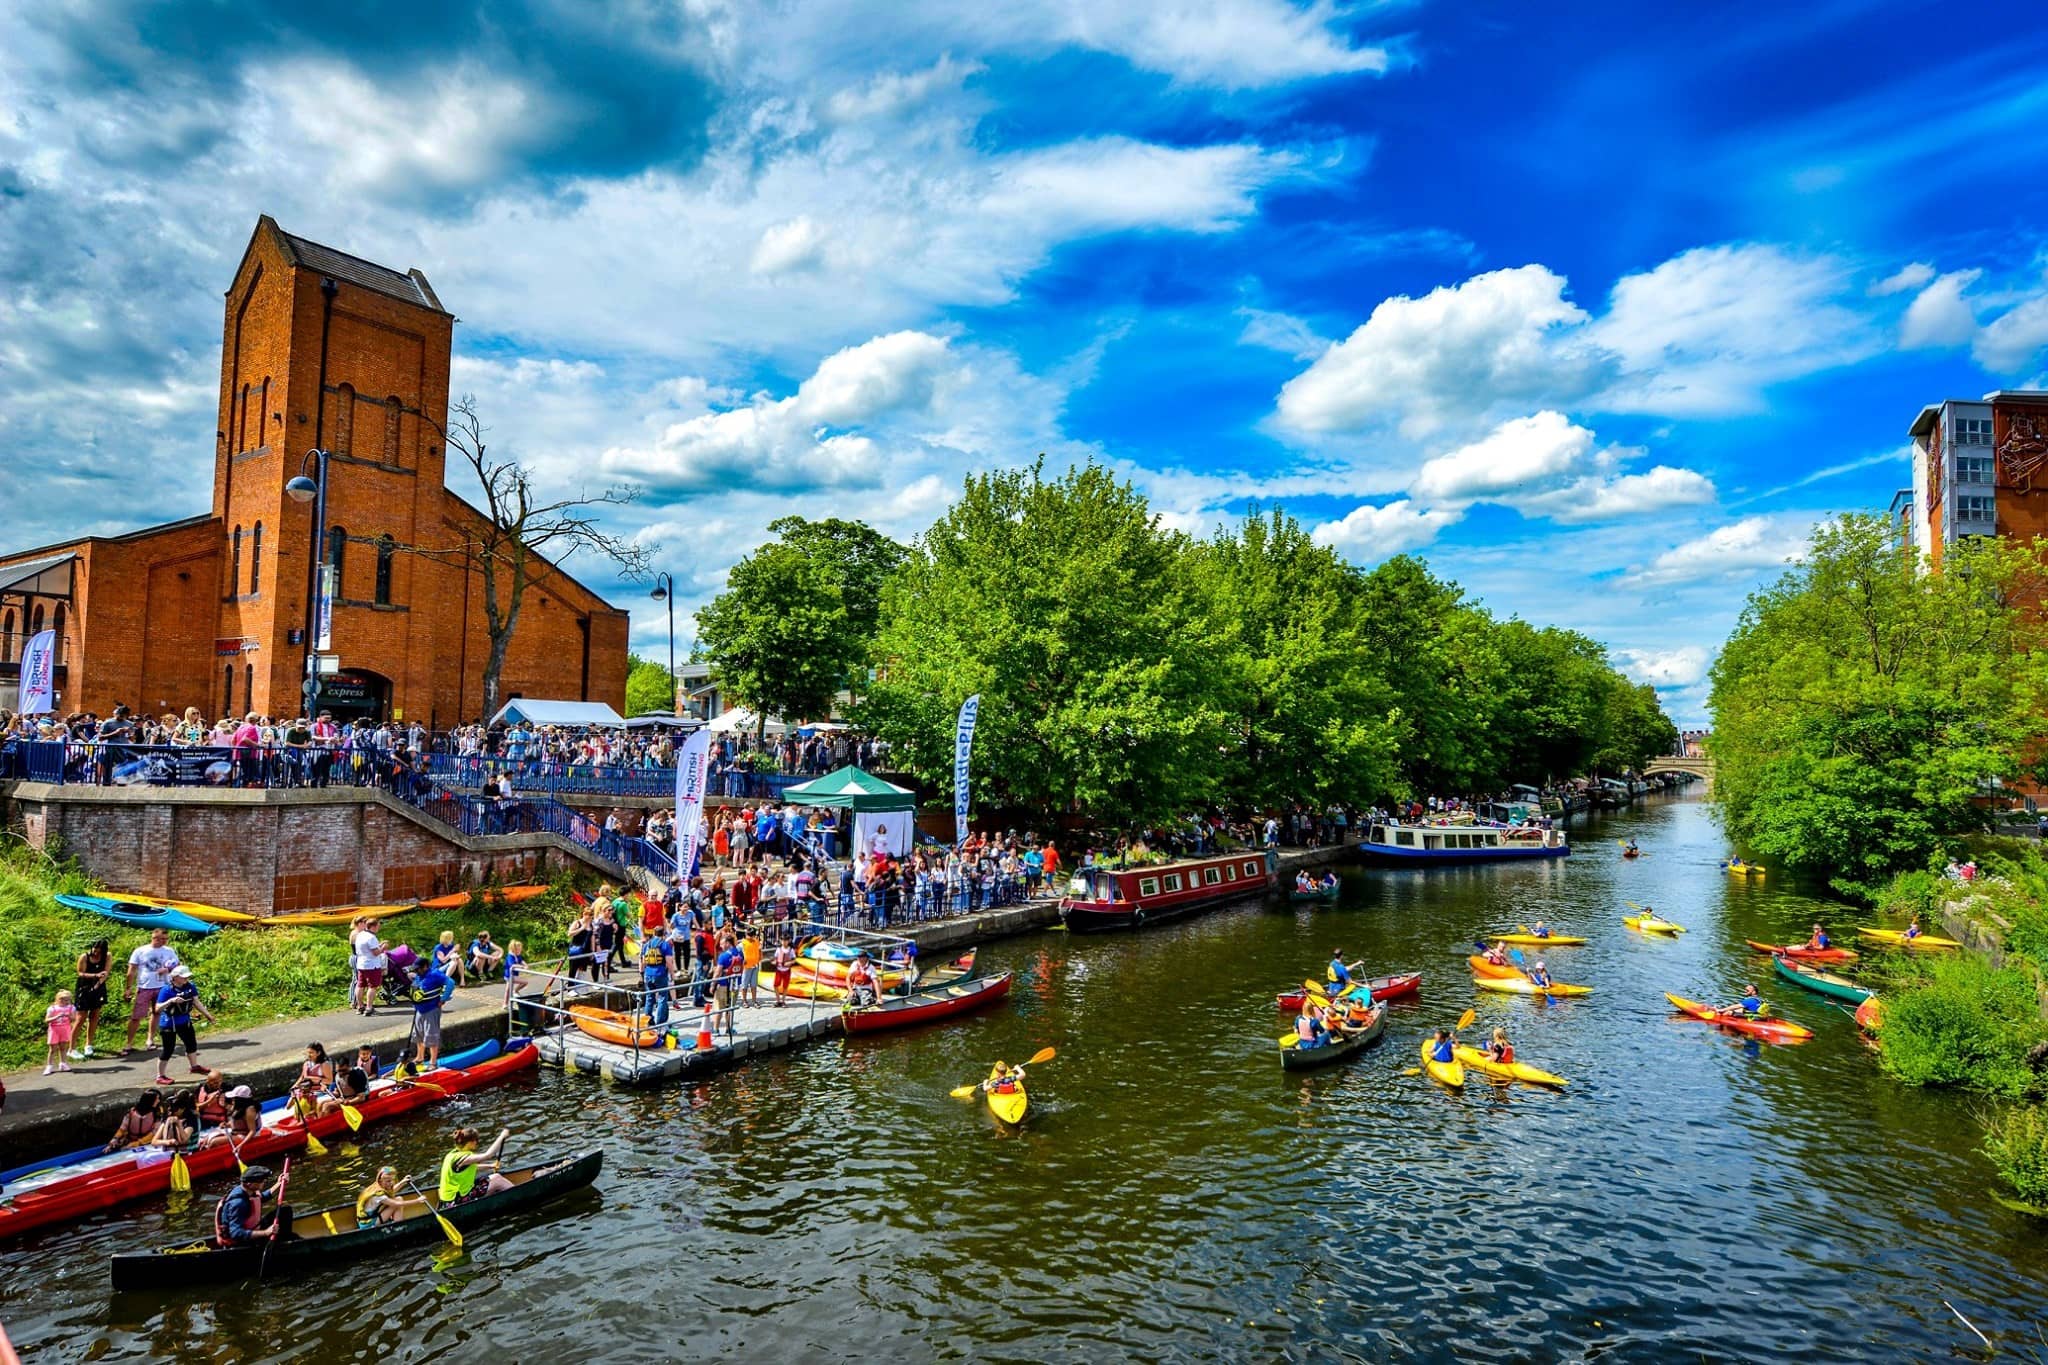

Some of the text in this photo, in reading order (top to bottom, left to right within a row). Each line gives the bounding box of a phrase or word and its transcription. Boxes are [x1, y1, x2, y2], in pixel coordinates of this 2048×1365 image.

[32, 649, 42, 686] BRITISH
[327, 688, 365, 698] express
[957, 701, 978, 816] PaddlePlus
